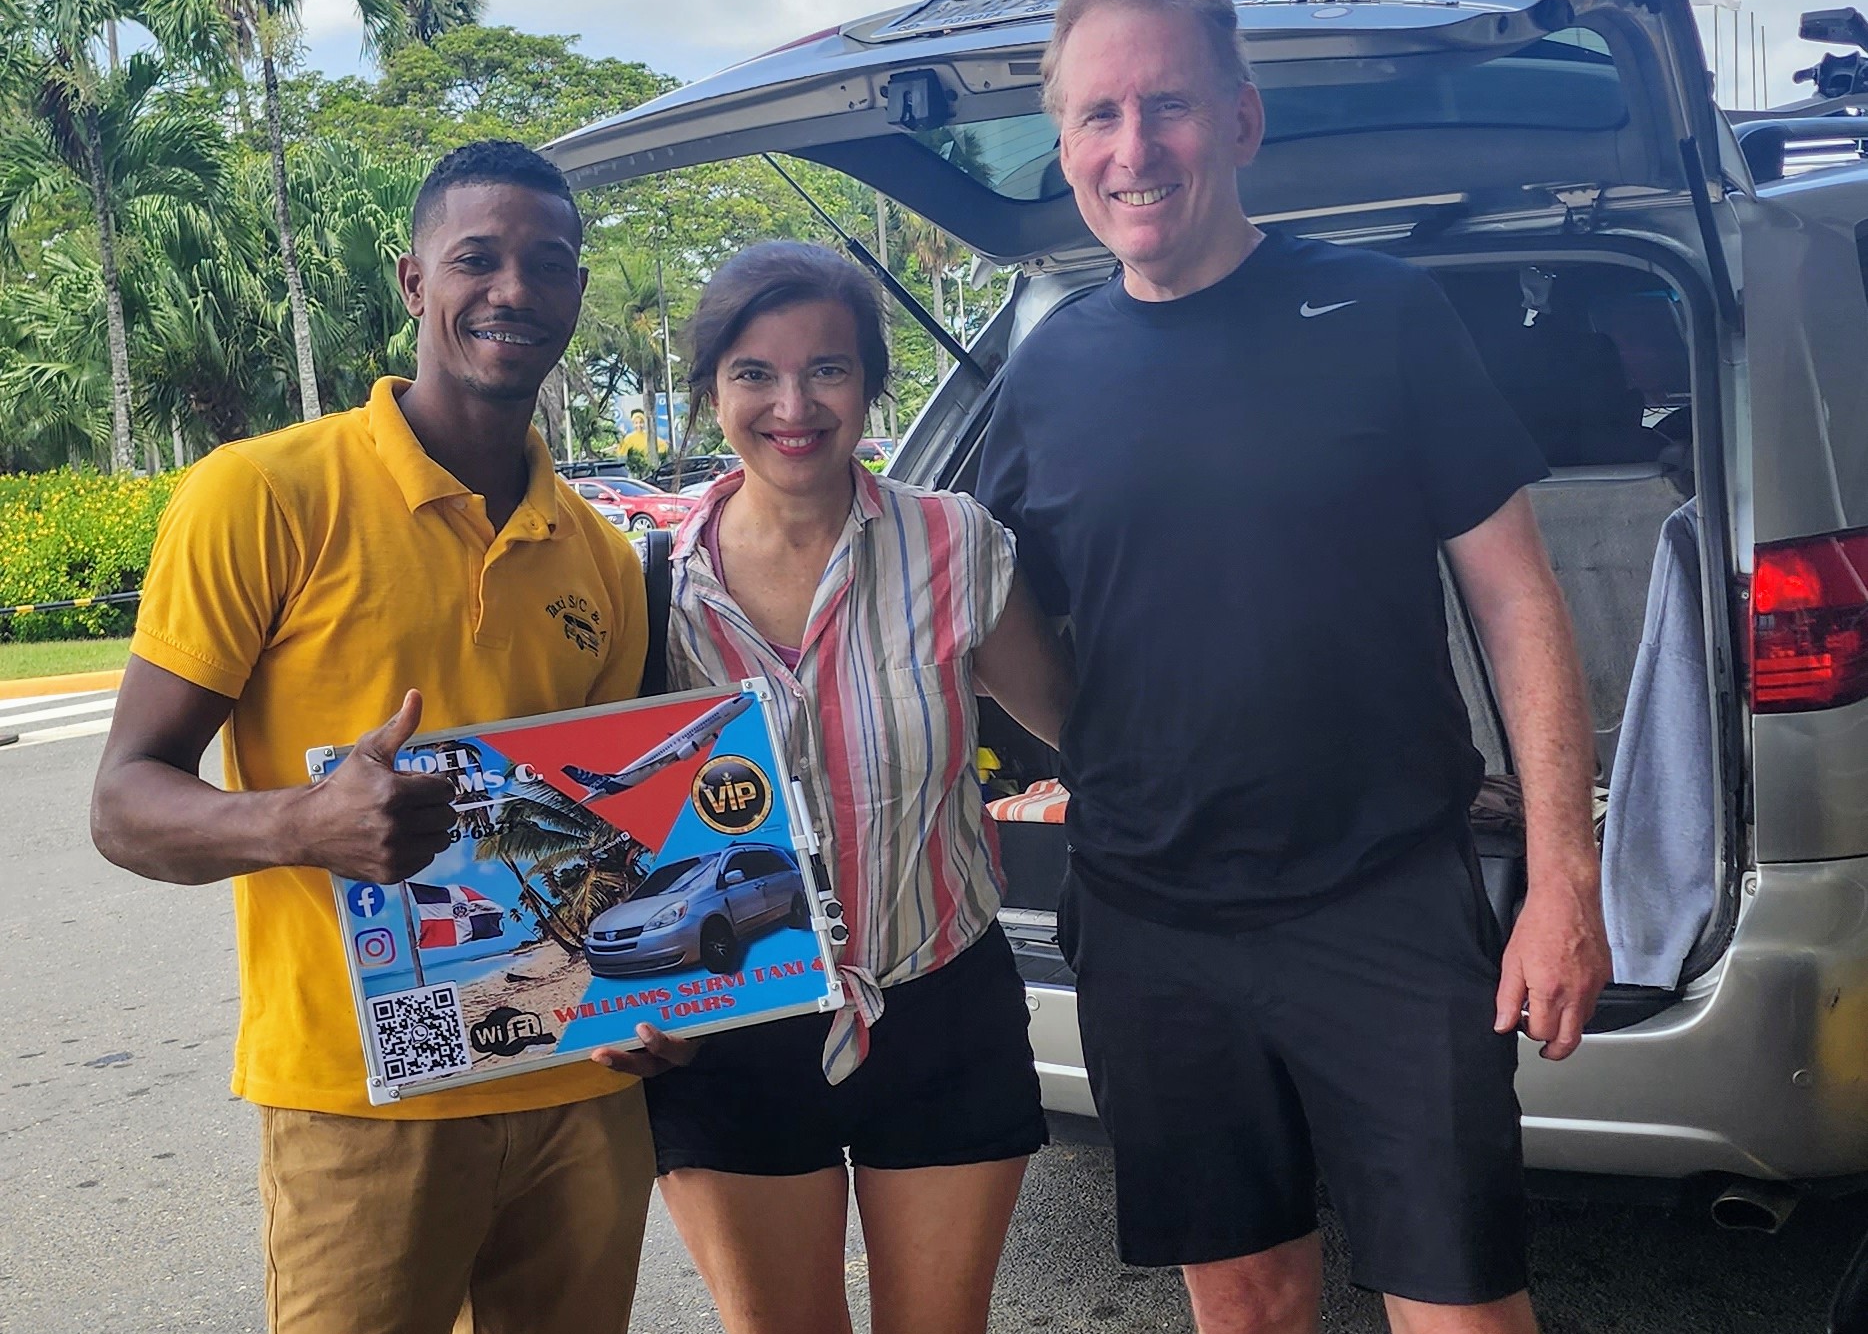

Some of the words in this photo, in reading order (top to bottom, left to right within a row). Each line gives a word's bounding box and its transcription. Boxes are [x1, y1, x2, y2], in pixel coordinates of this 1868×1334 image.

[703, 780, 757, 814] VIP
[553, 987, 672, 1023] WILLIAMS
[677, 970, 746, 998] SERVI
[750, 960, 806, 983] TAXI
[656, 994, 736, 1021] TOURS
